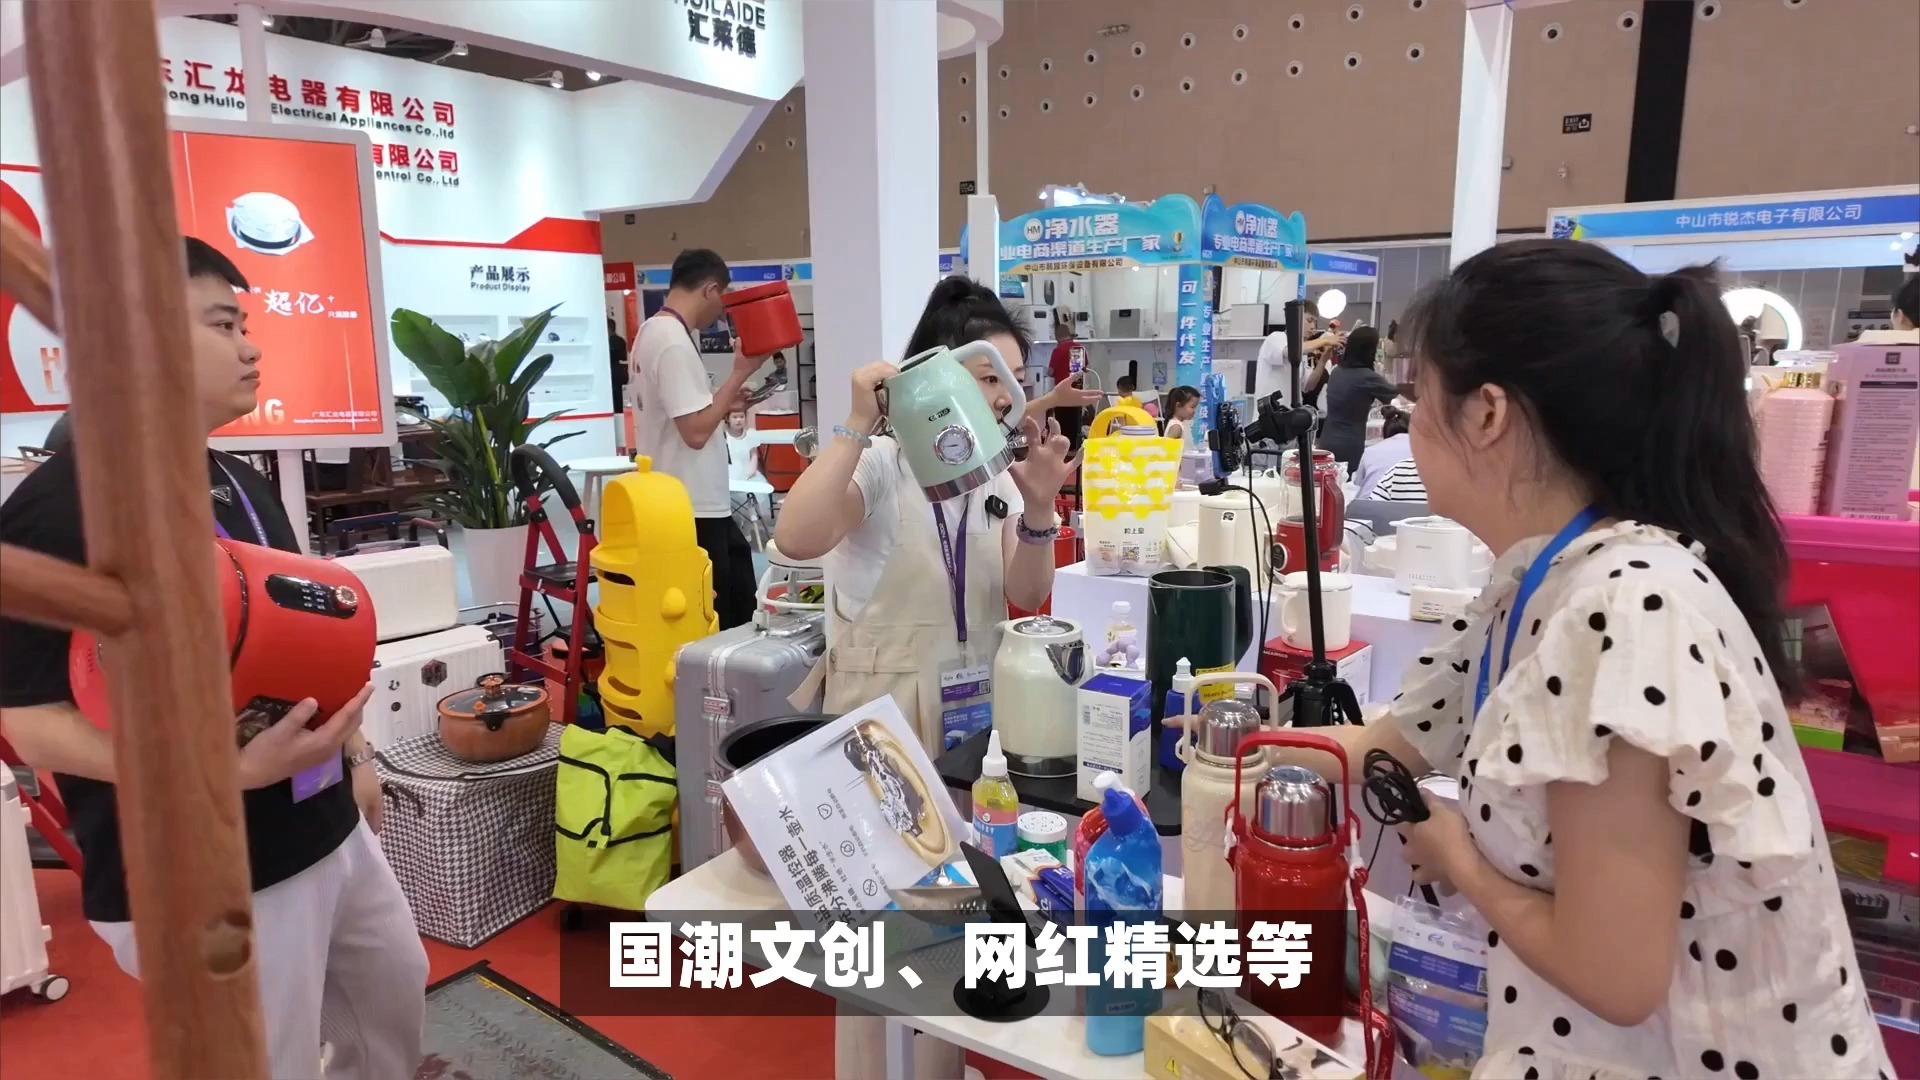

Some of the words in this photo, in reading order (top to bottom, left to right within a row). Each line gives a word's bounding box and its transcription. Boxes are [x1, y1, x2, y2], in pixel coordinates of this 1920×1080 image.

[270, 102, 336, 122] Electrical
[339, 112, 412, 133] Appliances
[375, 168, 412, 182] ontrol
[1026, 222, 1041, 234] HM
[1045, 212, 1119, 240] 净水器
[1245, 213, 1279, 239] 净水器
[1675, 203, 1863, 229] 中山市锐杰电子有限公司
[469, 263, 531, 283] 产品展示
[470, 281, 501, 292] Product
[502, 283, 531, 293] Display
[1178, 280, 1198, 365] 可一件代发
